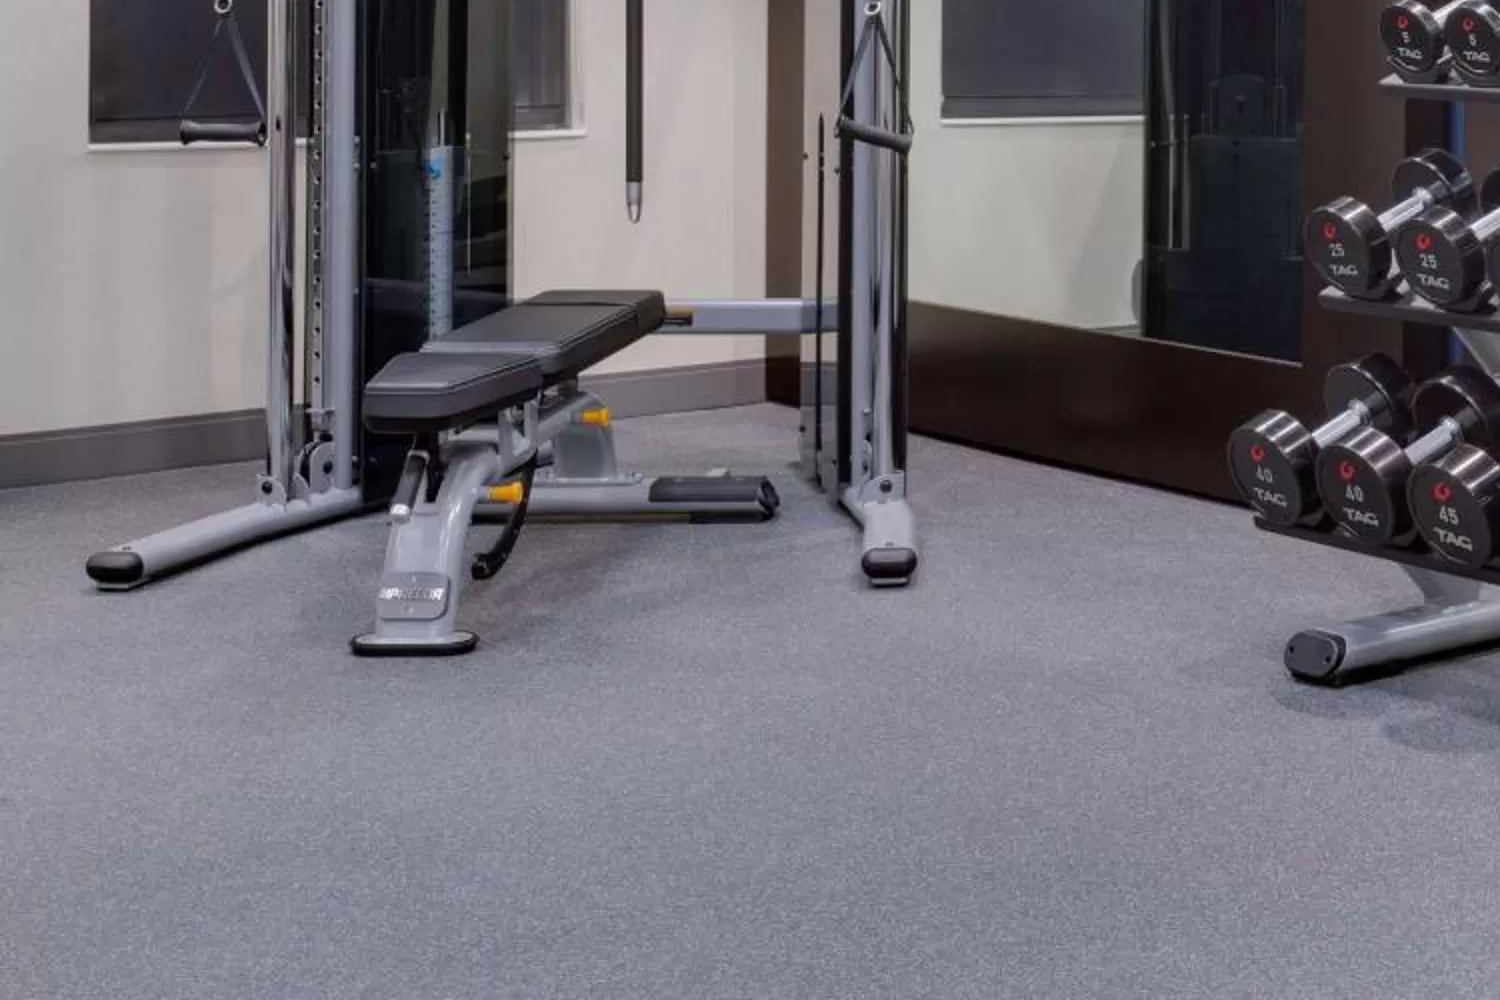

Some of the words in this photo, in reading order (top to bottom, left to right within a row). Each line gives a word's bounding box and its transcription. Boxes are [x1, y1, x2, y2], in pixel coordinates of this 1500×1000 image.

[1463, 51, 1490, 63] TAG
[1328, 243, 1345, 257] 25
[1419, 253, 1437, 269] 25
[1328, 264, 1358, 276] TAG
[1416, 273, 1449, 289] TAG
[1255, 464, 1273, 483] 40
[1253, 487, 1287, 507] TAG
[1345, 485, 1364, 502] 40
[1342, 507, 1379, 527] TAG
[1438, 505, 1459, 525] 45
[1433, 526, 1473, 551] TAG
